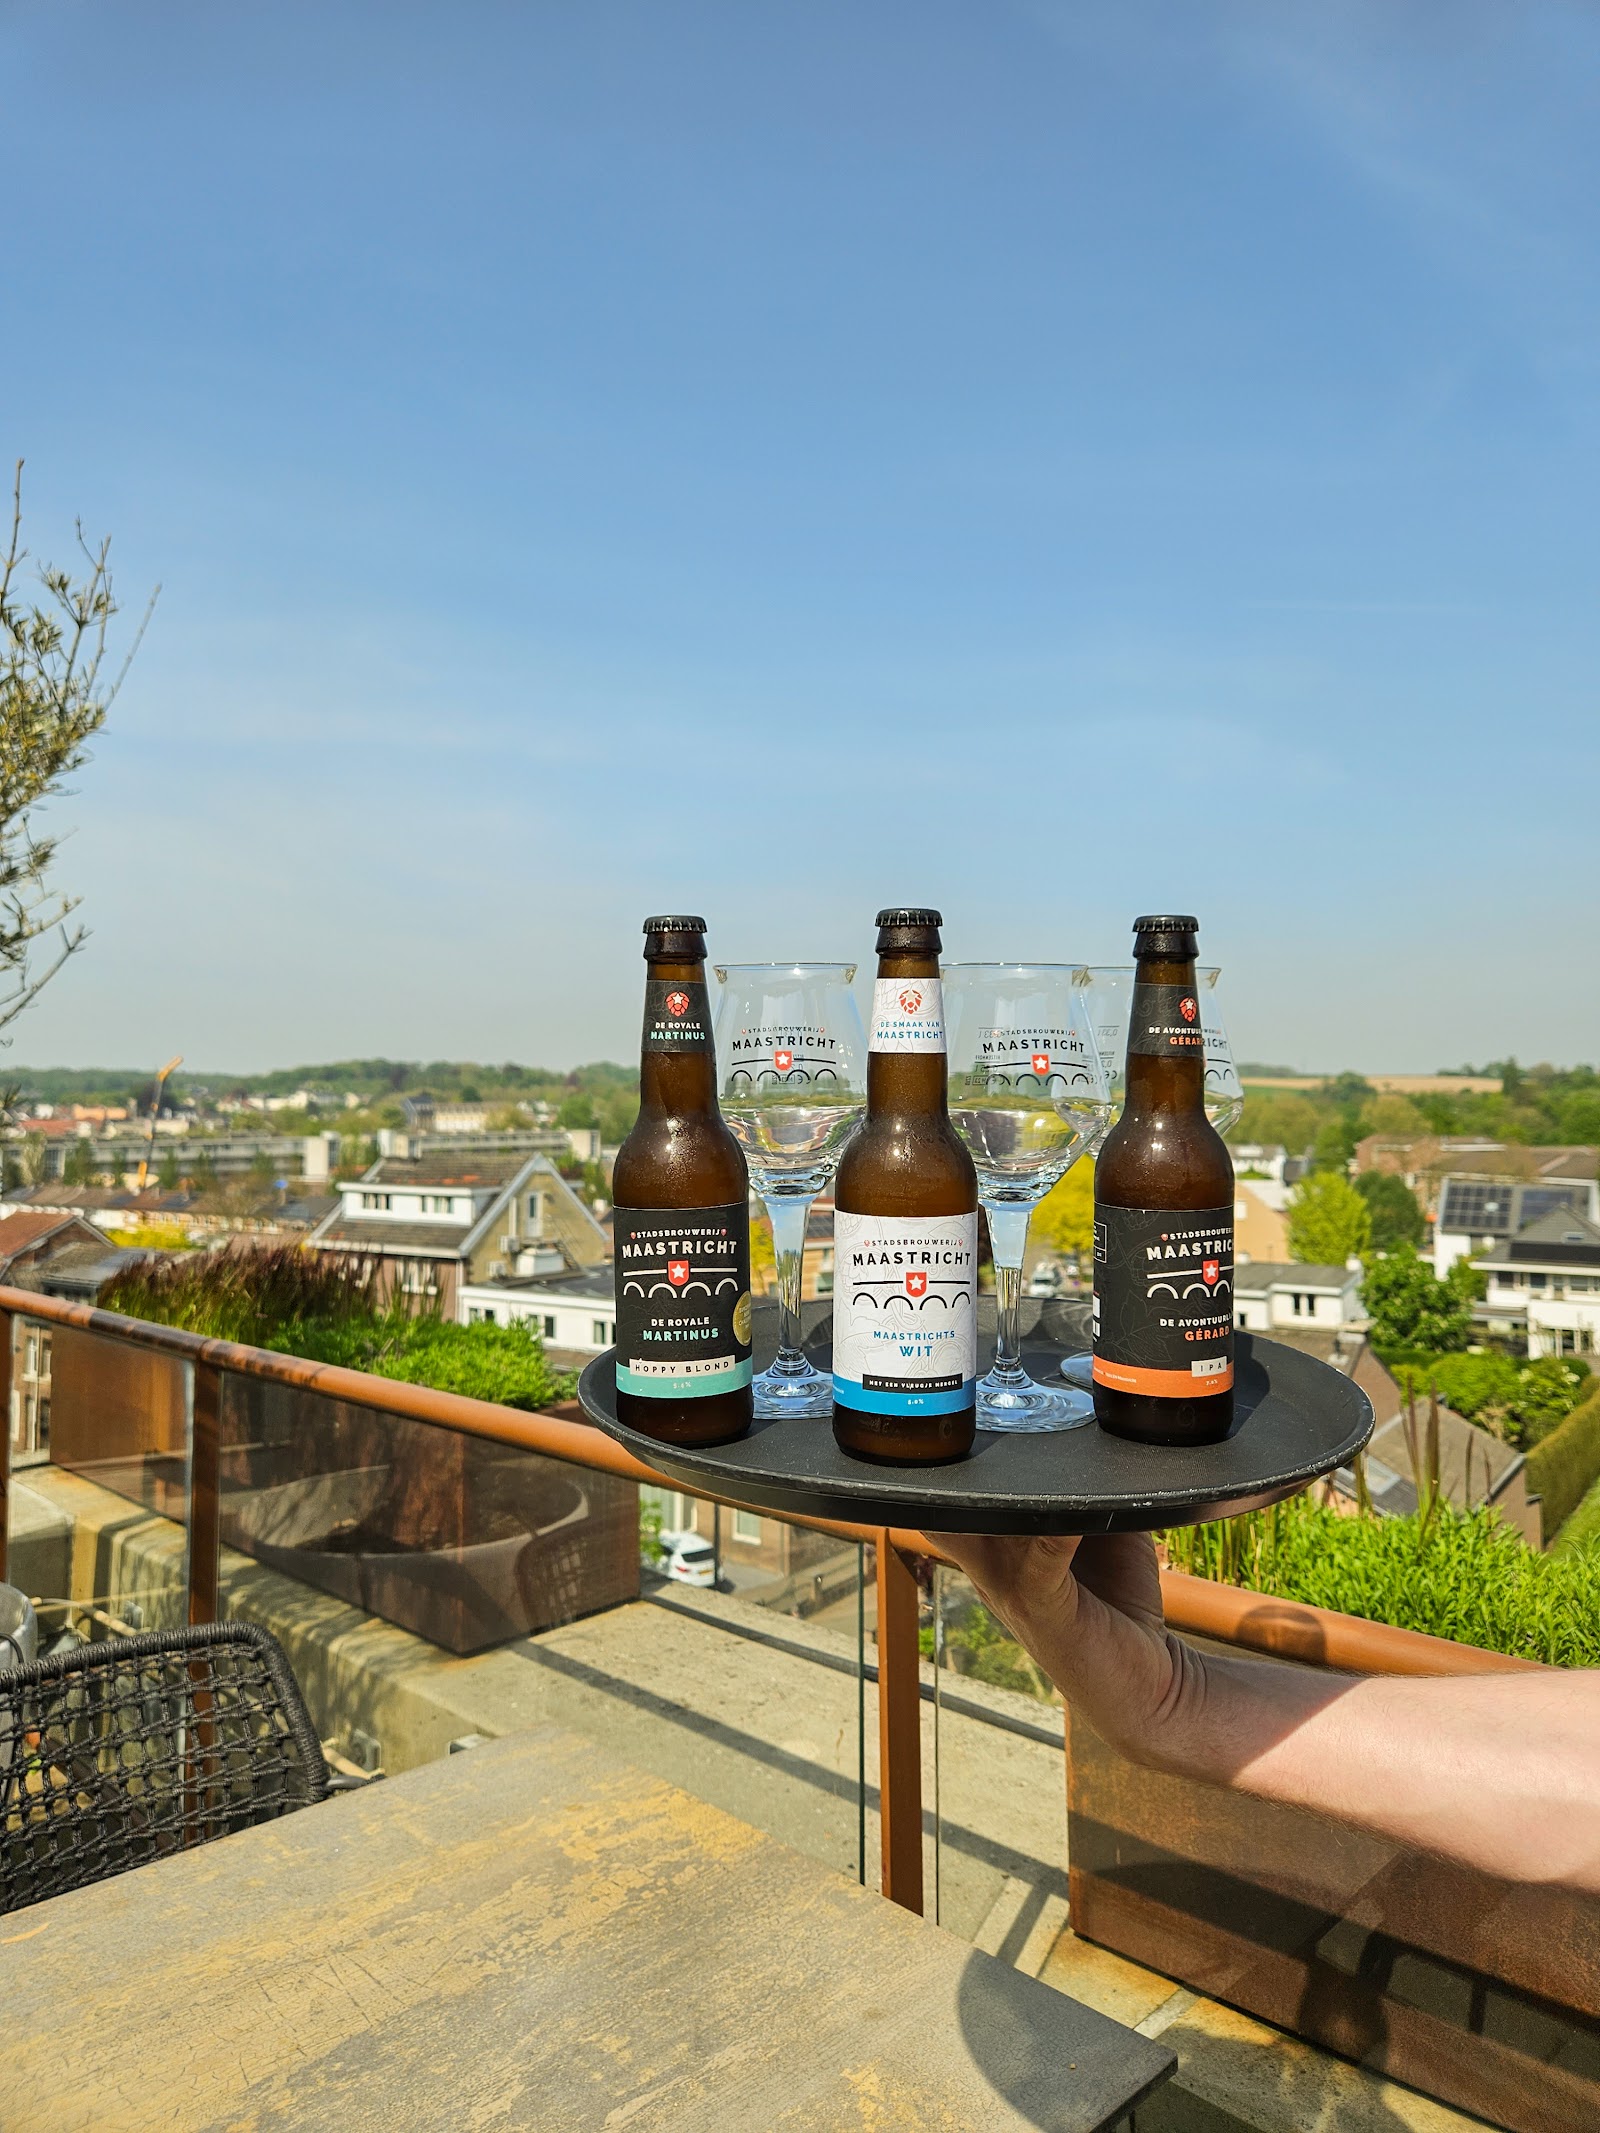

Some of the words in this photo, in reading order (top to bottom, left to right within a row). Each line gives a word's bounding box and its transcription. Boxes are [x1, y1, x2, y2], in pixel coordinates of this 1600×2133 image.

[655, 1022, 666, 1030] DE
[668, 1021, 701, 1030] ROYALE
[1148, 1026, 1160, 1034] DE
[650, 1031, 706, 1041] MARTINUS
[877, 1030, 943, 1039] MAASTRICHT
[732, 1036, 836, 1051] MAASTRICHT
[982, 1038, 1084, 1054] MAASTRICHT
[636, 1228, 721, 1239] STADSBROUWERIJ
[872, 1238, 958, 1247] STADSBROUWERIJ
[622, 1240, 738, 1259] MAASTRICHT
[853, 1251, 971, 1266] MAASTRICHT
[651, 1318, 665, 1327] DE
[667, 1316, 710, 1327] ROYALE
[1159, 1318, 1175, 1327] DE
[643, 1327, 719, 1341] MARTINUS
[873, 1330, 955, 1341] MAASTRICHTS
[1184, 1325, 1230, 1341] GÉRARD
[899, 1345, 933, 1357] WIT
[635, 1364, 676, 1374] HOPPY
[685, 1361, 729, 1373] BLOND
